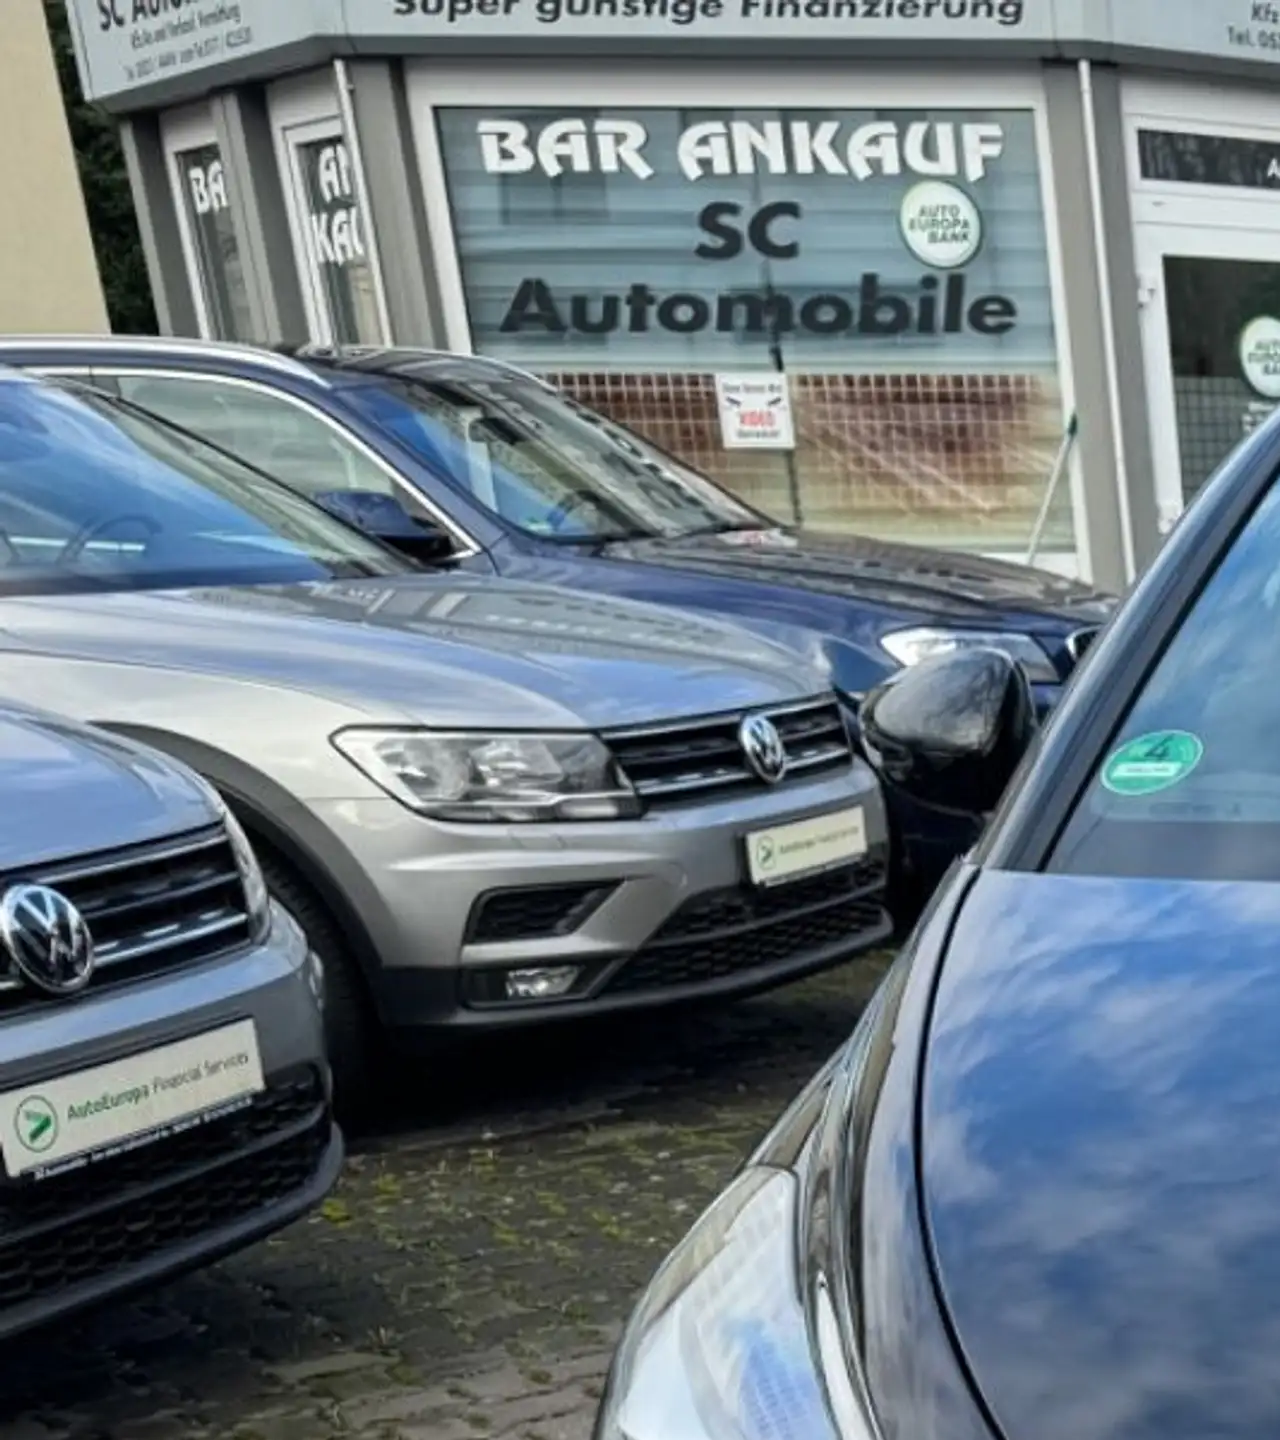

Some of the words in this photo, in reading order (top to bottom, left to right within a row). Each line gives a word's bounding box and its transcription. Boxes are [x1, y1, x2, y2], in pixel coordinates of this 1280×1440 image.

[477, 118, 653, 178] BAR
[678, 120, 1004, 182] ANKAUF
[694, 201, 803, 260] SC
[919, 203, 961, 217] AUTO
[501, 273, 1018, 335] Automobile
